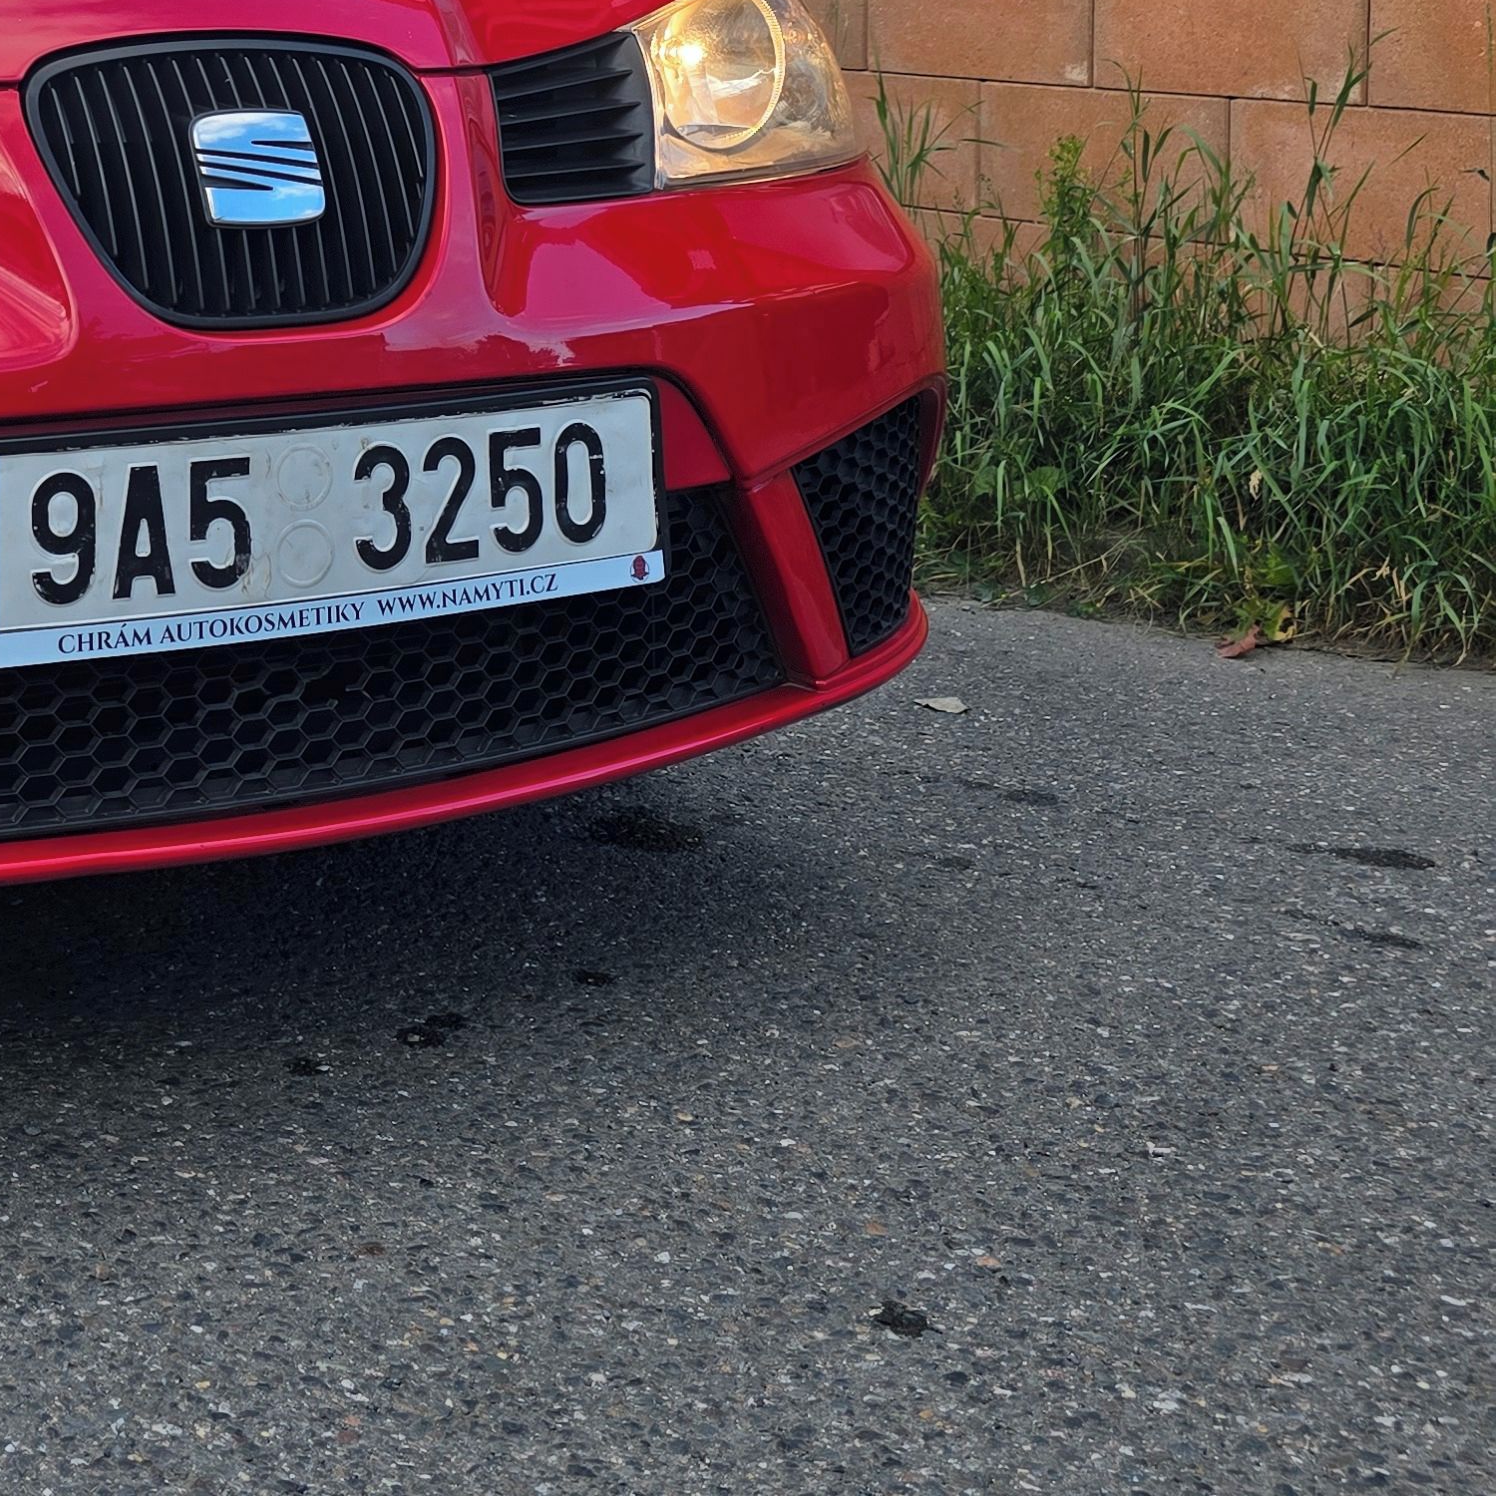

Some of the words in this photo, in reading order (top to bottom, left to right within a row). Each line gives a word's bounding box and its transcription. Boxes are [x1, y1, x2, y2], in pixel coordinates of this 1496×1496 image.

[30, 455, 253, 606] 9A5
[352, 421, 608, 572] 3250
[57, 619, 154, 655] CHRÁM
[159, 600, 366, 645] AUTOKOSMETIKY
[376, 573, 559, 616] WWW.NAMYTI.CZ
